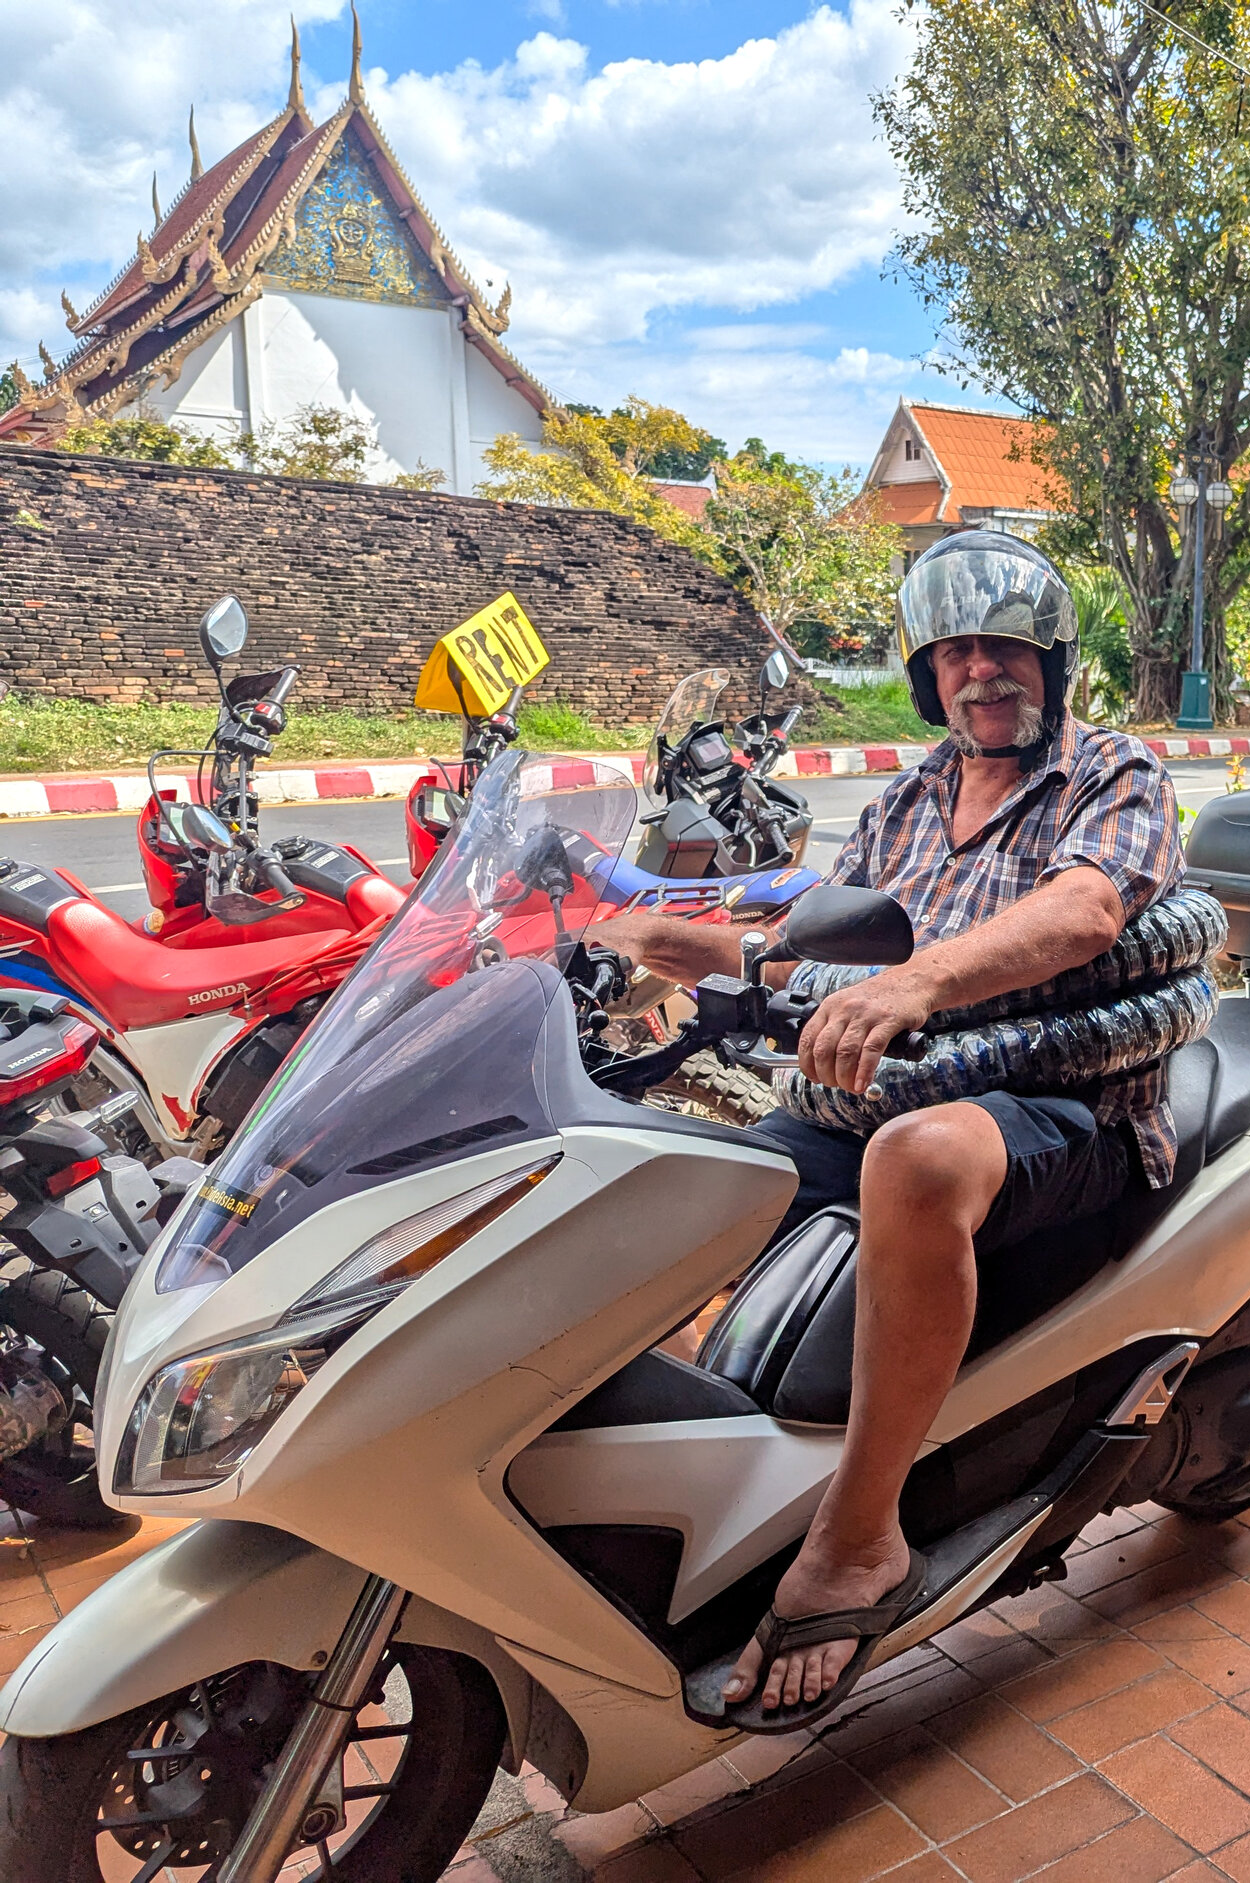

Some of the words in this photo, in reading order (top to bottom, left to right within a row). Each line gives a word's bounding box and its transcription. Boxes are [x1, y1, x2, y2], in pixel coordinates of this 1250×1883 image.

[455, 605, 539, 703] RENT
[732, 911, 766, 920] HONDA
[188, 982, 251, 1006] HONDA
[8, 1048, 53, 1070] HONDA
